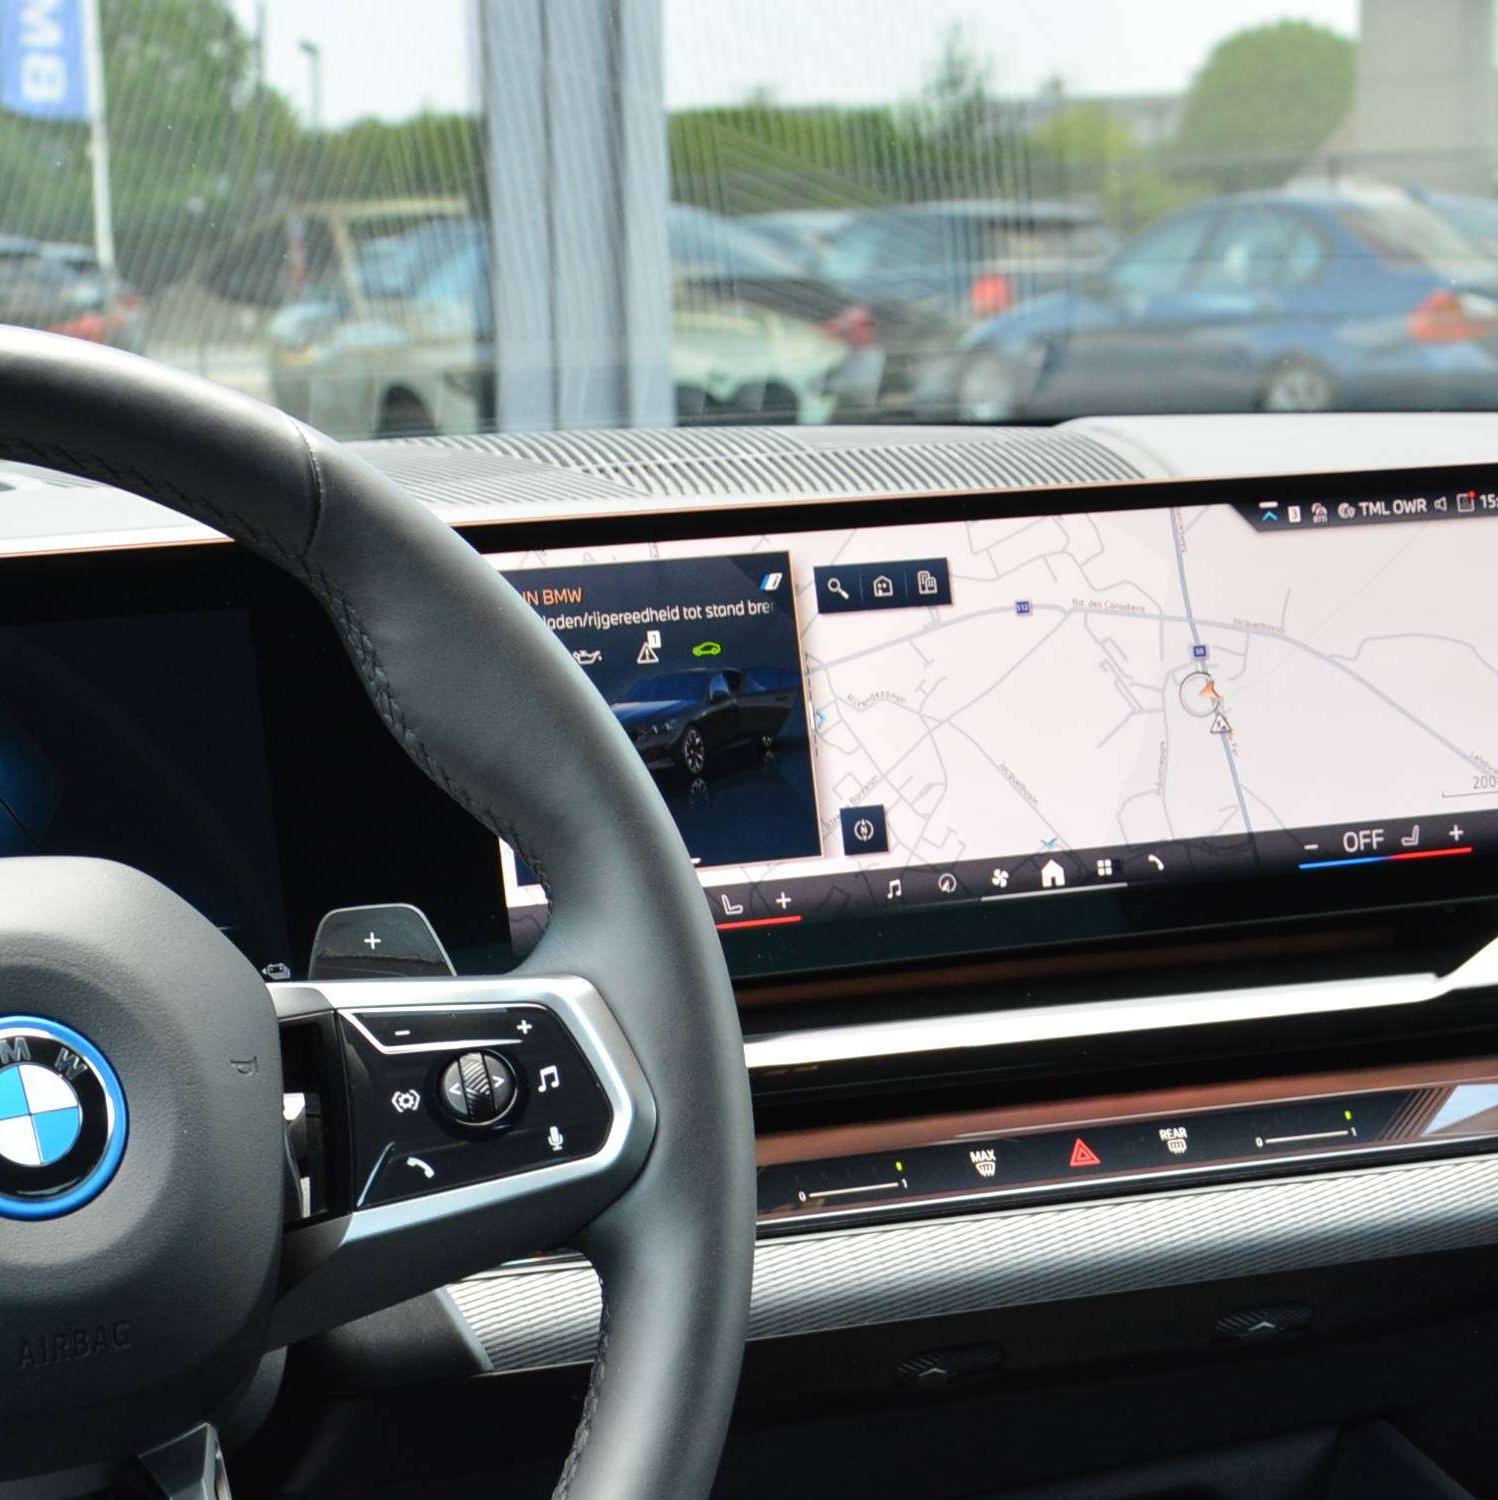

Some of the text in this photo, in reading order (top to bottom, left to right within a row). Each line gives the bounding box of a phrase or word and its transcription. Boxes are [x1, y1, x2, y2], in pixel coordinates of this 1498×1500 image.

[1359, 498, 1428, 517] TML OWR
[542, 587, 582, 605] BMW
[682, 605, 702, 620] tot
[705, 600, 744, 618] stand
[1343, 829, 1385, 853] OFF
[1159, 1127, 1188, 1141] REAR
[969, 1149, 996, 1163] MAX
[18, 1321, 133, 1370] AIRBAG
